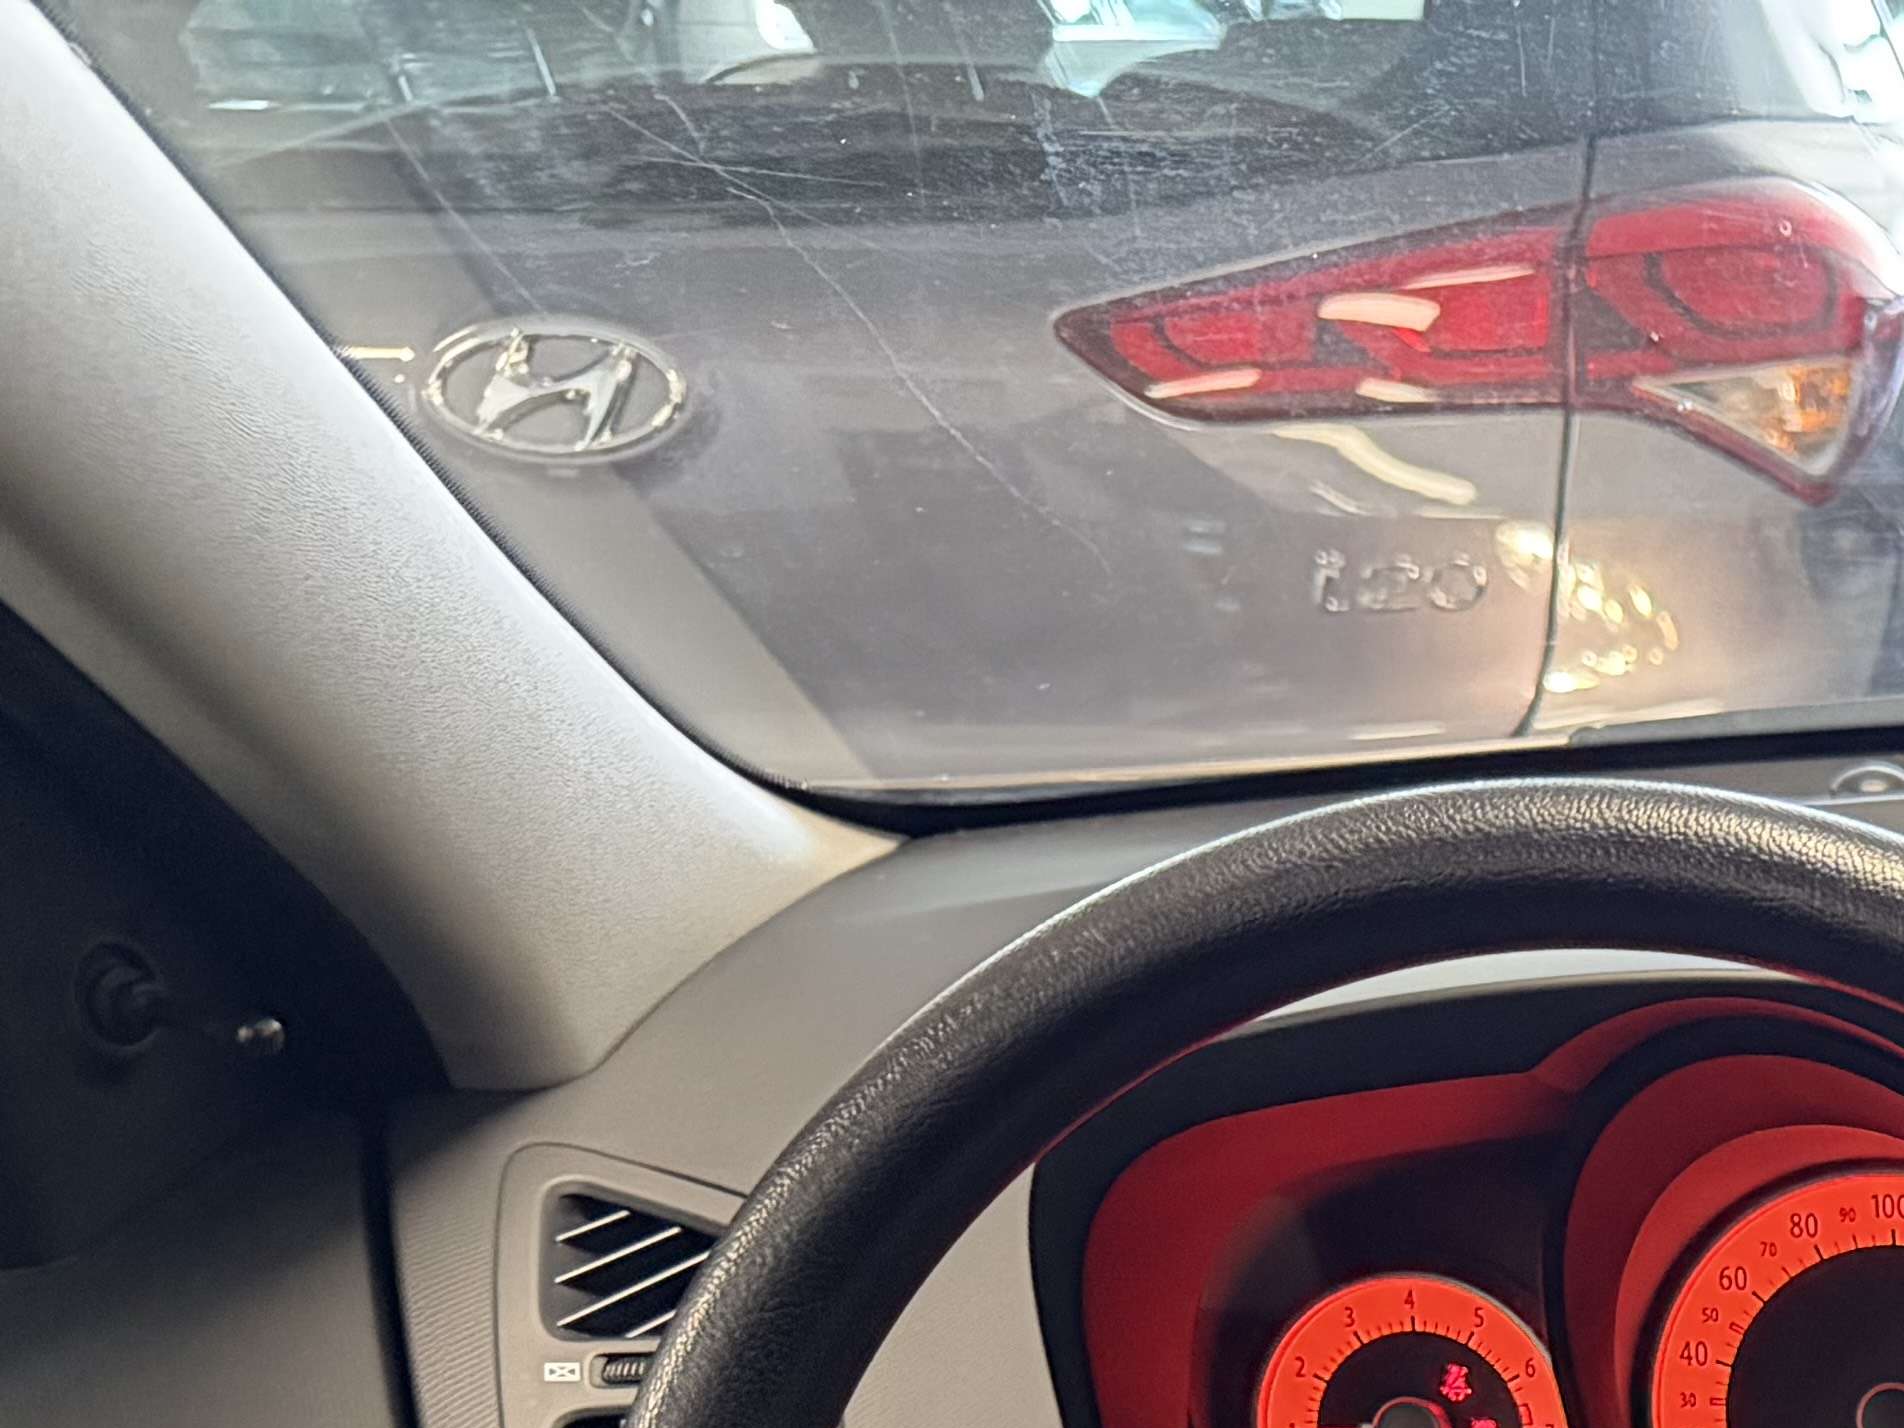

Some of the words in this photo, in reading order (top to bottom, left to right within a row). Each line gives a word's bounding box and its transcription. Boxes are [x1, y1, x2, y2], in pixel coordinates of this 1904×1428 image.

[1789, 1212, 1818, 1238] 80
[1839, 1208, 1856, 1223] 90
[1760, 1241, 1777, 1257] 70
[1719, 1266, 1747, 1291] 60
[1404, 1289, 1415, 1309] 4
[1343, 1307, 1356, 1328] 3
[1474, 1307, 1484, 1328] 5
[1702, 1308, 1719, 1323] 50
[1680, 1341, 1708, 1366] 40
[1295, 1356, 1307, 1378] 2
[1525, 1356, 1536, 1378] 6
[1680, 1392, 1696, 1408] 30
